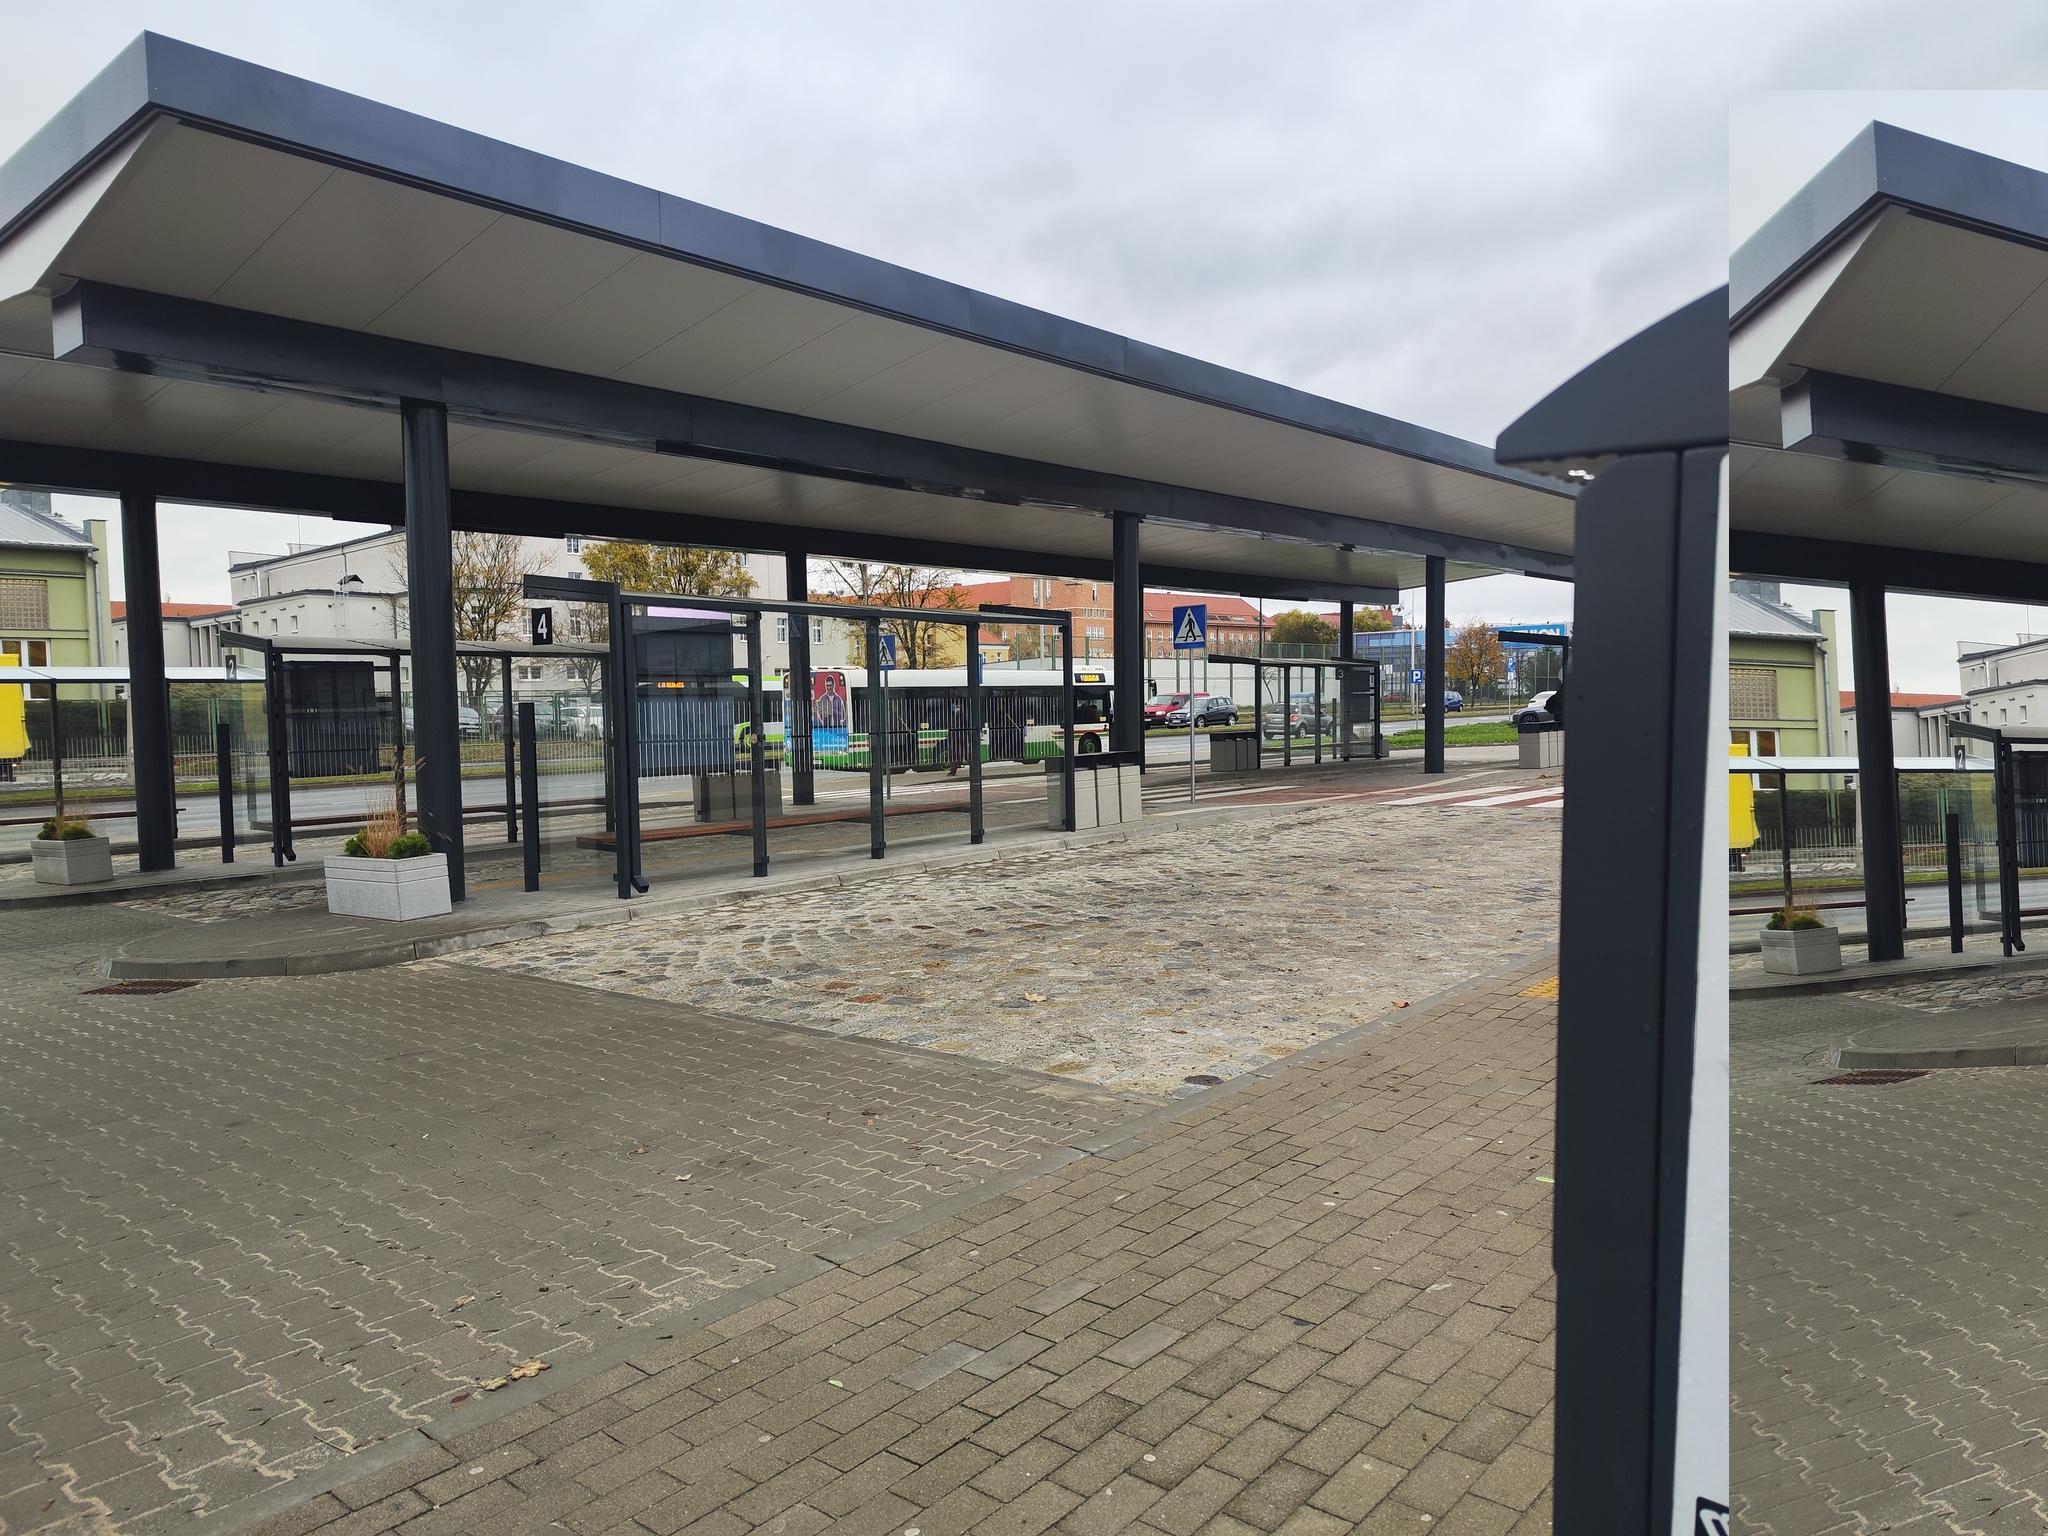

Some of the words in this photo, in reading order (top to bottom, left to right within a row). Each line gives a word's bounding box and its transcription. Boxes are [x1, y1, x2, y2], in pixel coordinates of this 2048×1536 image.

[537, 613, 547, 639] 4
[229, 659, 234, 678] 2
[1338, 669, 1344, 679] 3
[1412, 671, 1421, 682] P
[1958, 749, 1963, 768] 2
